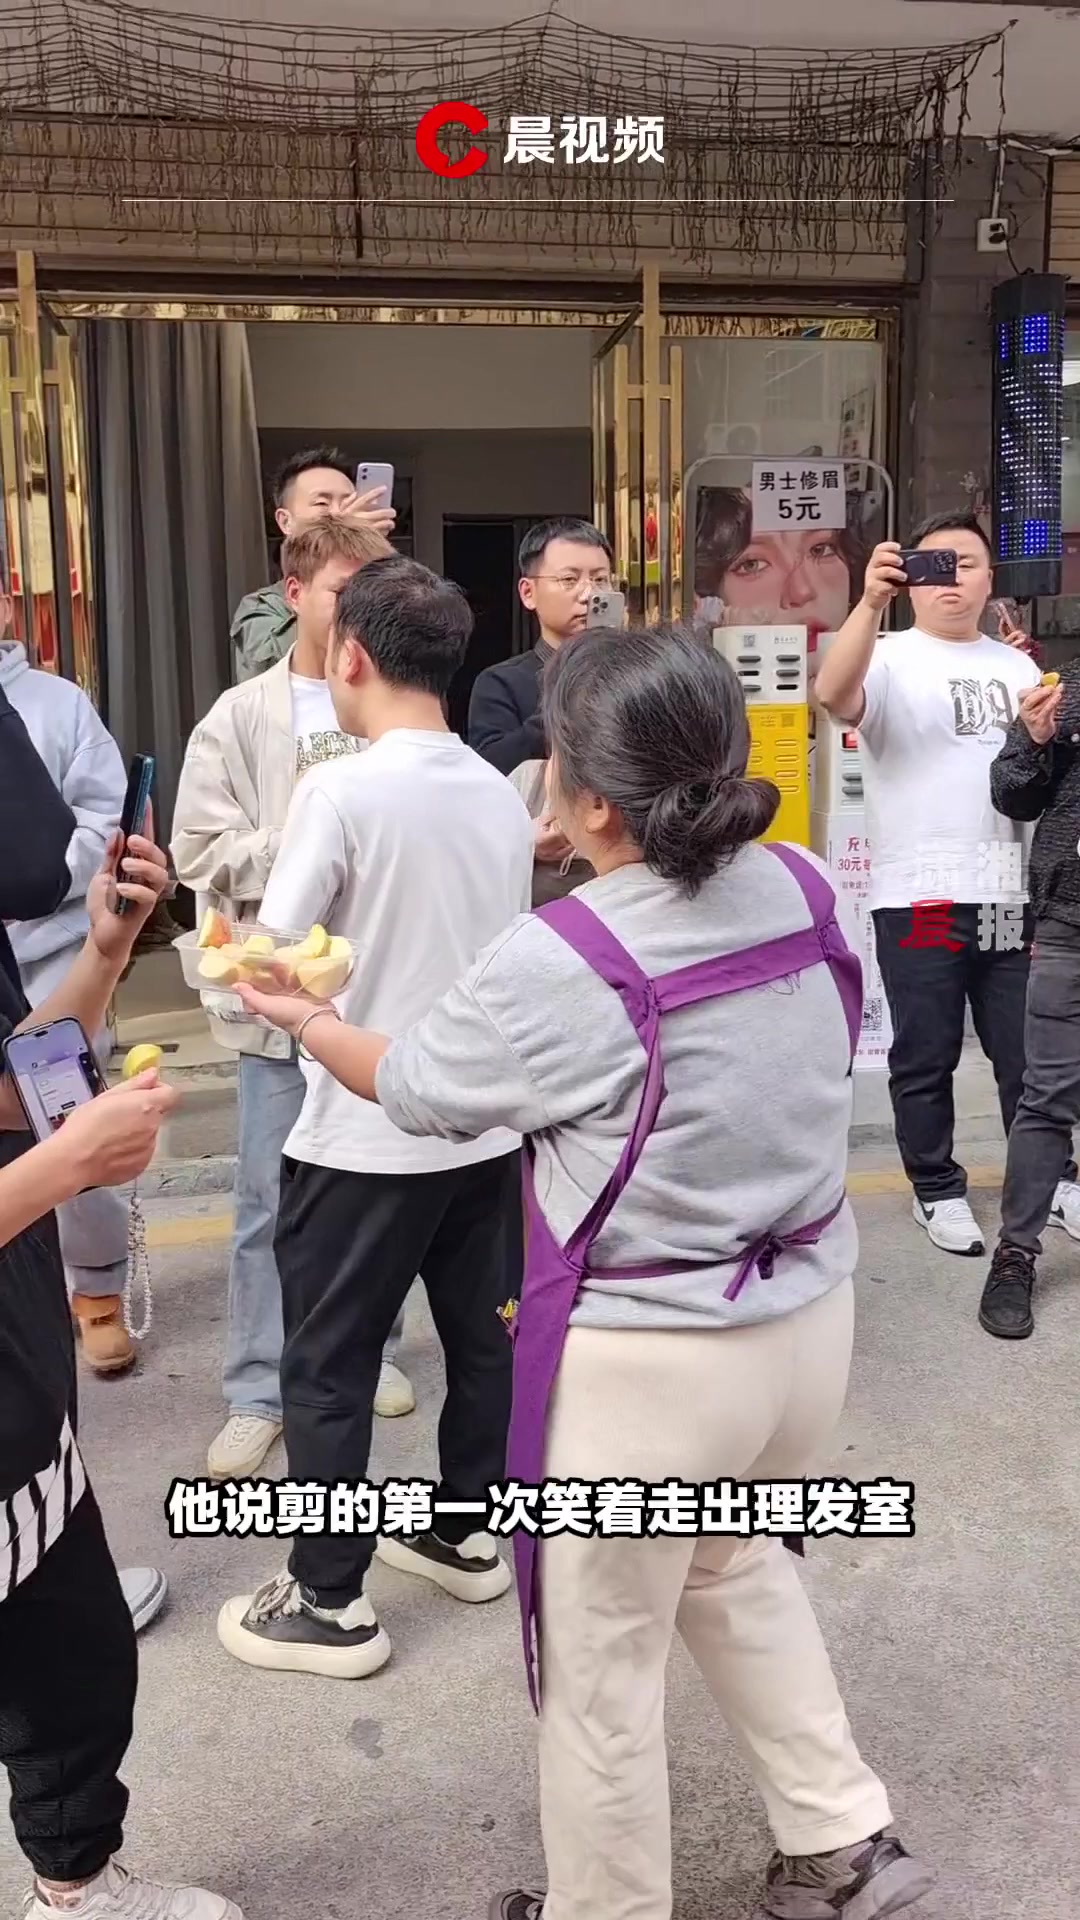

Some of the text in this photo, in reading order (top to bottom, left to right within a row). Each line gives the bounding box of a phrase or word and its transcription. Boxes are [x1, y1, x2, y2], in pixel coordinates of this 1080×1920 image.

[759, 470, 839, 491] 男士修眉
[778, 496, 822, 521] 5元
